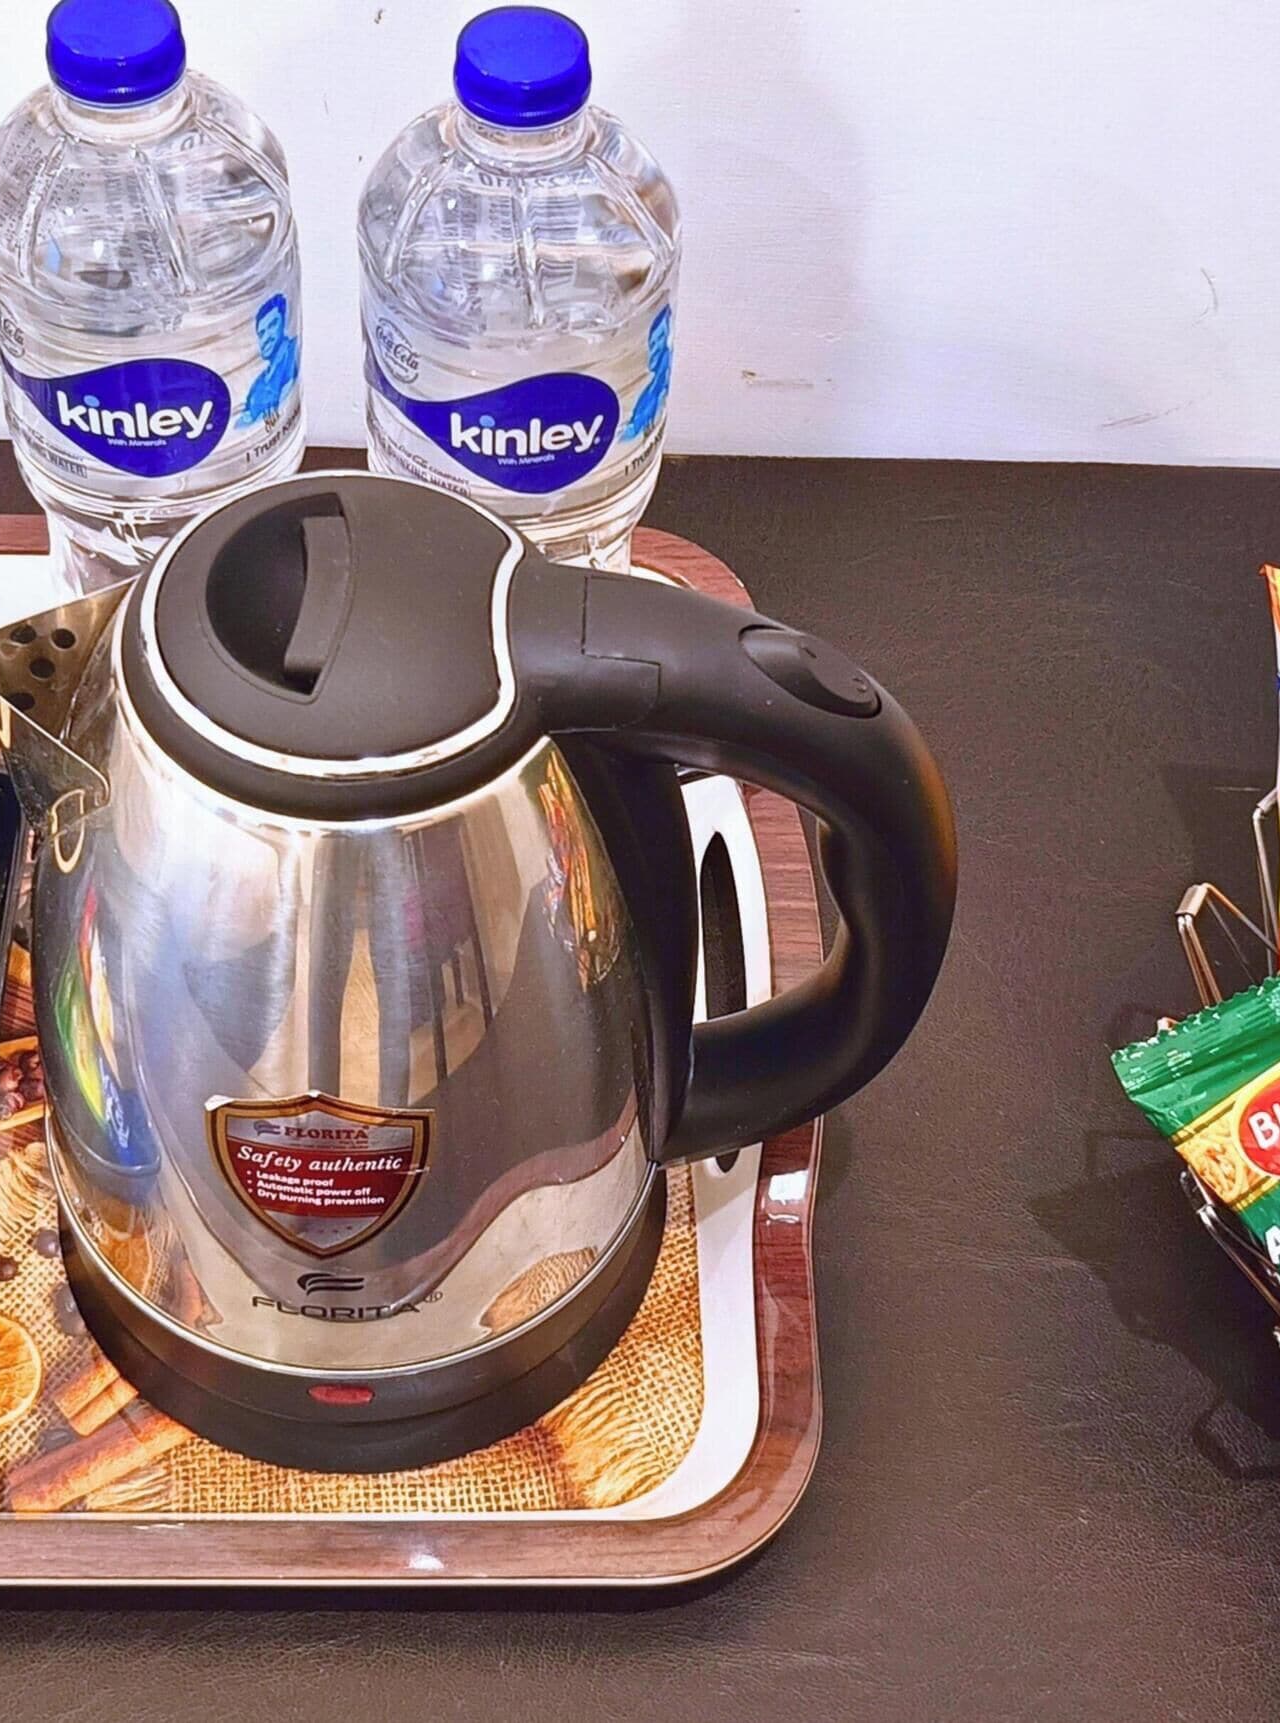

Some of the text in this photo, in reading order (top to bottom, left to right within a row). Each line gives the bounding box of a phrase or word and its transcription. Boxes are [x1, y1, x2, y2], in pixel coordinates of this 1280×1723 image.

[56, 391, 214, 439] kinley
[450, 412, 604, 455] kinley
[284, 1125, 369, 1140] FLORITA
[238, 1145, 403, 1172] Safety authentic
[256, 1171, 334, 1187] Leakage proof
[256, 1180, 370, 1197] Automatic power off
[257, 1189, 384, 1206] Dry burning prevention
[252, 1296, 420, 1320] FLORITA
